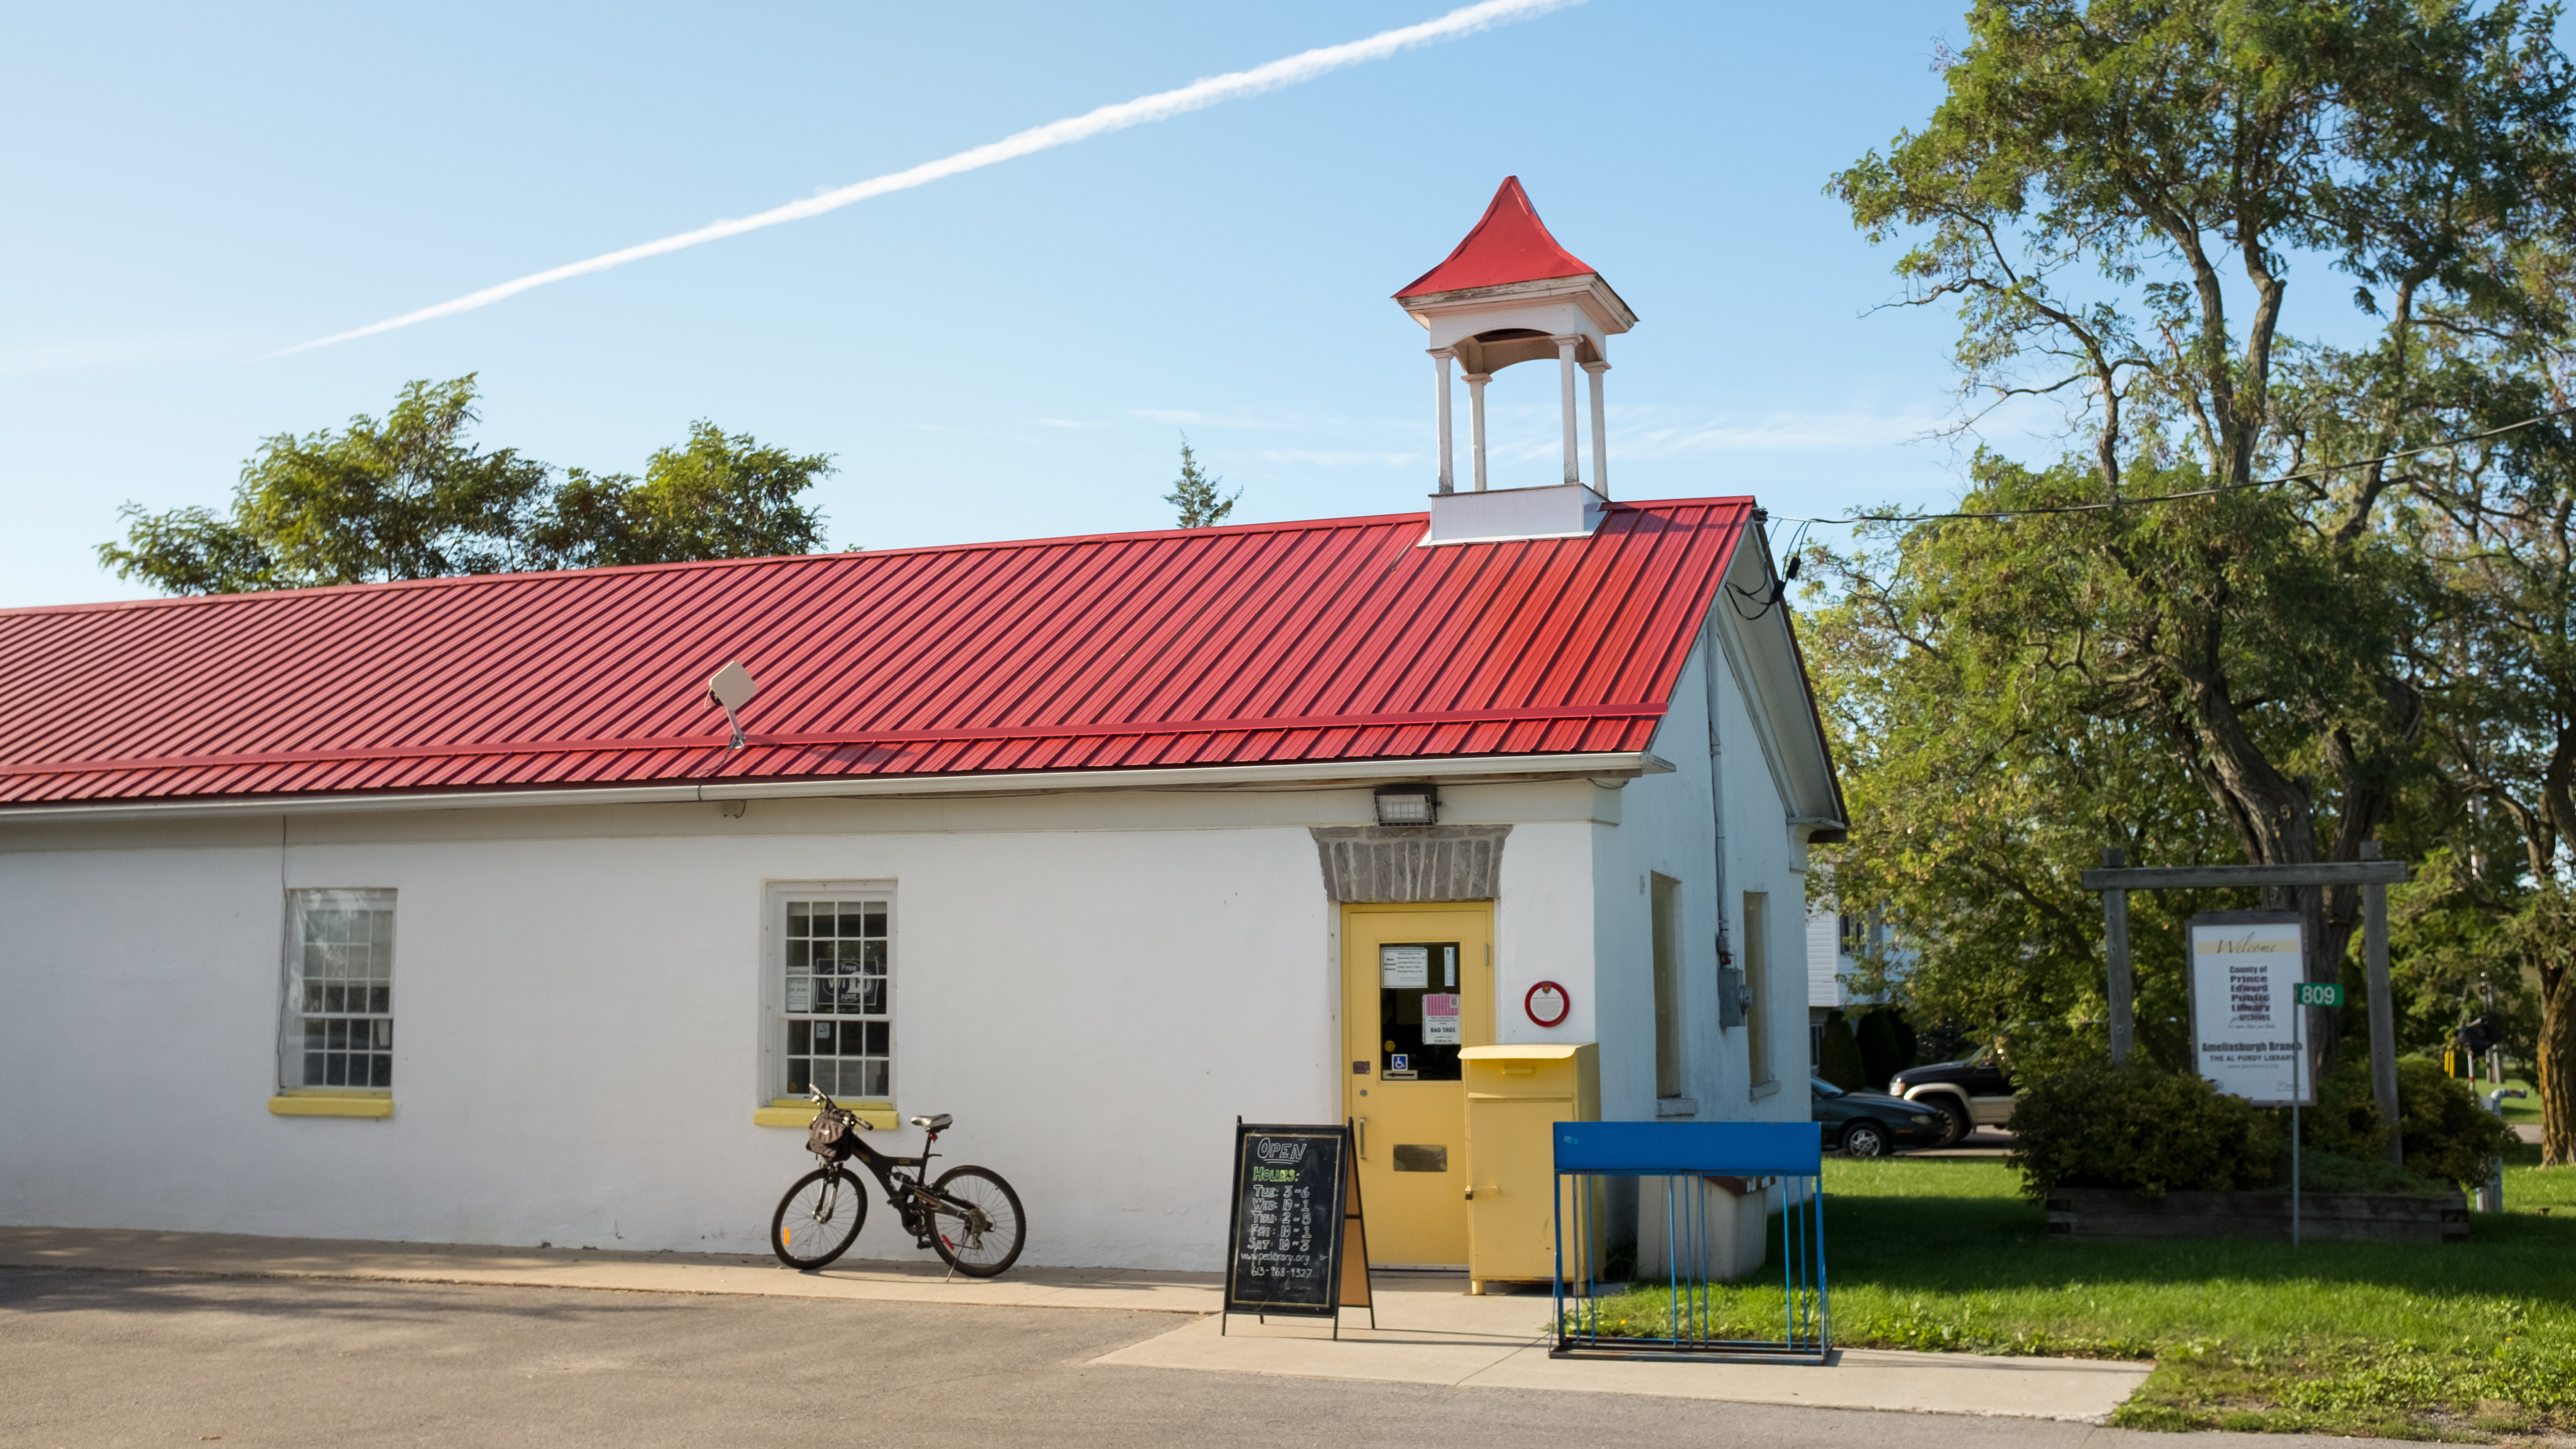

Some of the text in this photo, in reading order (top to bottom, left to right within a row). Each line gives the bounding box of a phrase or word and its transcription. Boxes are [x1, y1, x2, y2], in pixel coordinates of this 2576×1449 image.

[2217, 931, 2277, 953] Welcome
[2302, 985, 2335, 1005] 809
[2202, 1042, 2303, 1052] Ameliasburgh Branh
[1257, 1138, 1307, 1161] OPEN
